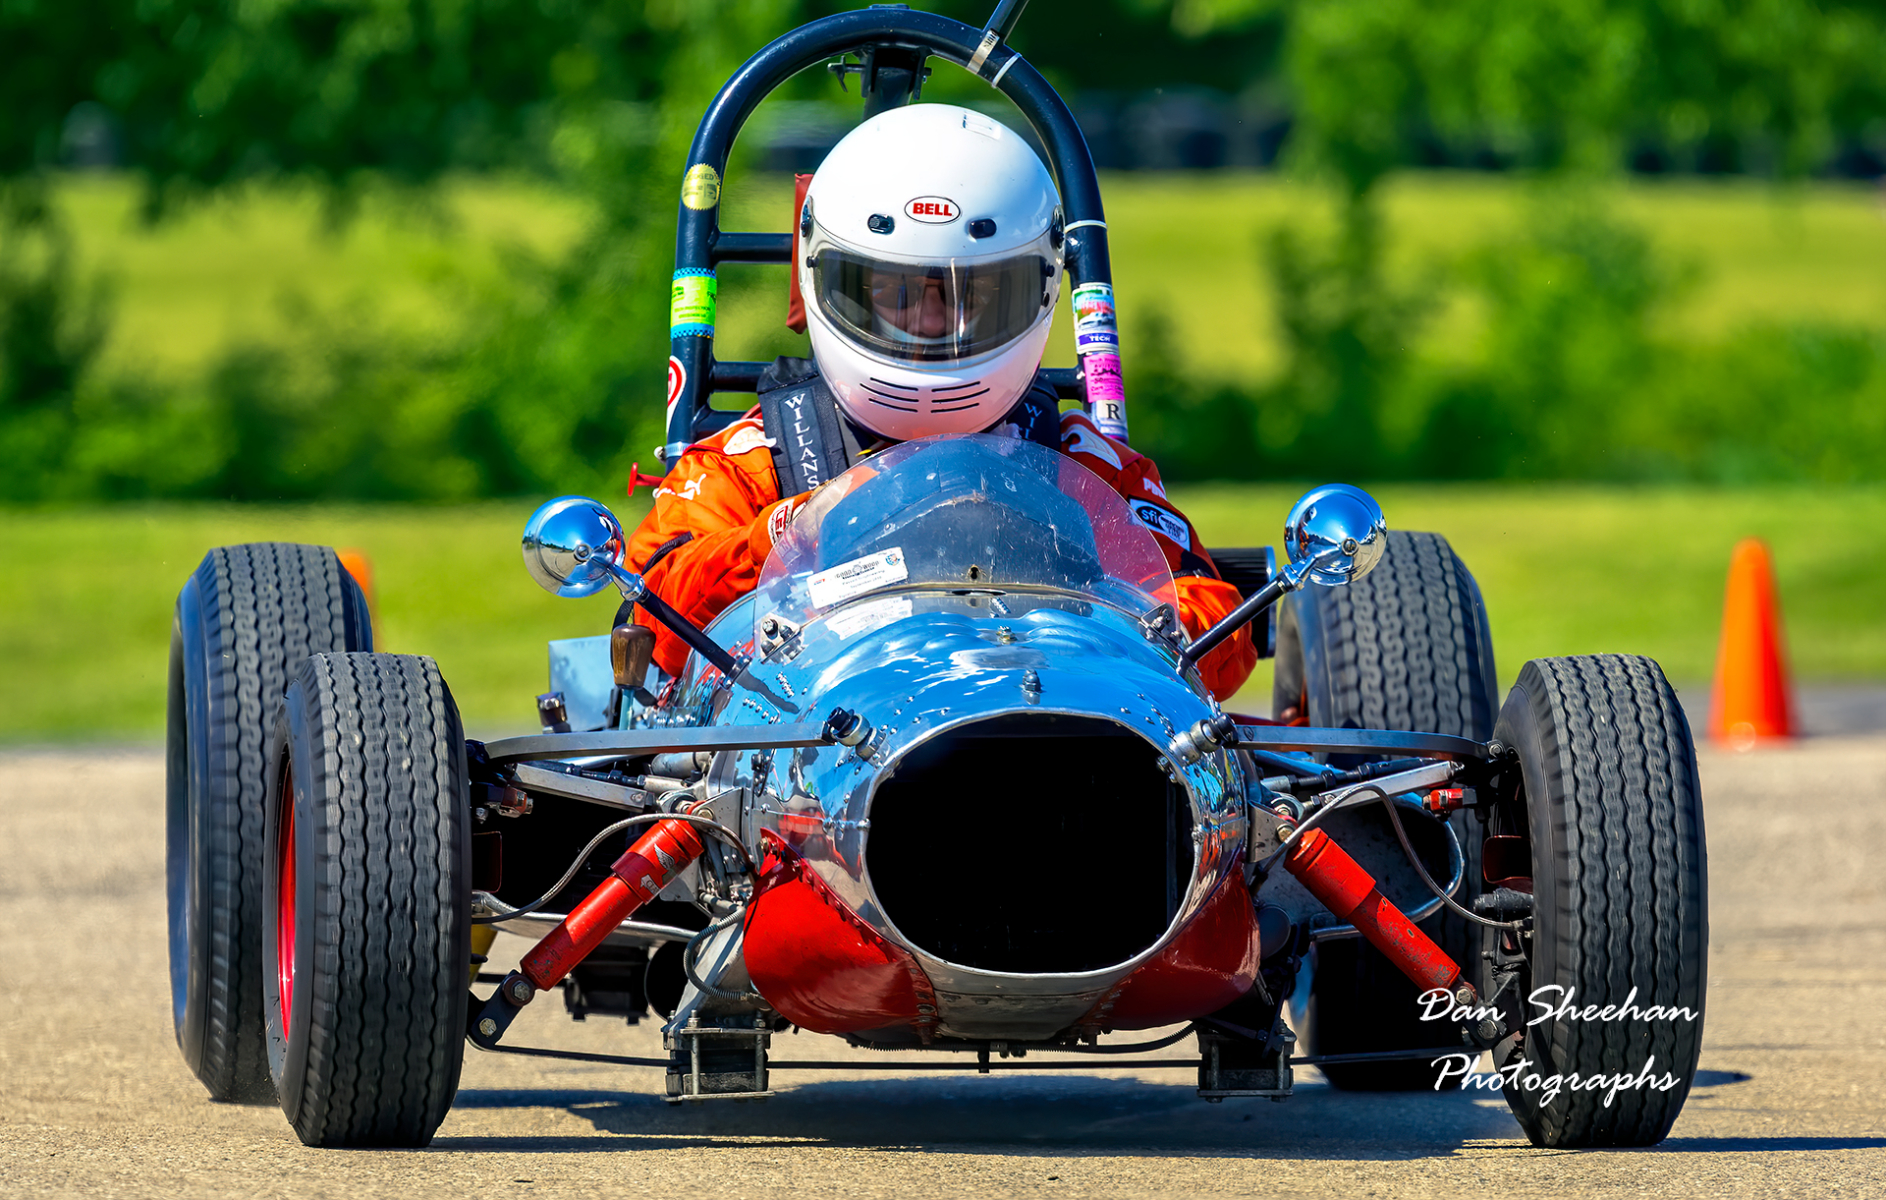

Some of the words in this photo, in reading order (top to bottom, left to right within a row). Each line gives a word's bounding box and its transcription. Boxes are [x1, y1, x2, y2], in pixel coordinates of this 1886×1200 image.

[912, 202, 953, 217] BELL
[1106, 403, 1121, 420] R
[784, 393, 820, 490] WILLANS
[1141, 509, 1158, 524] sfi
